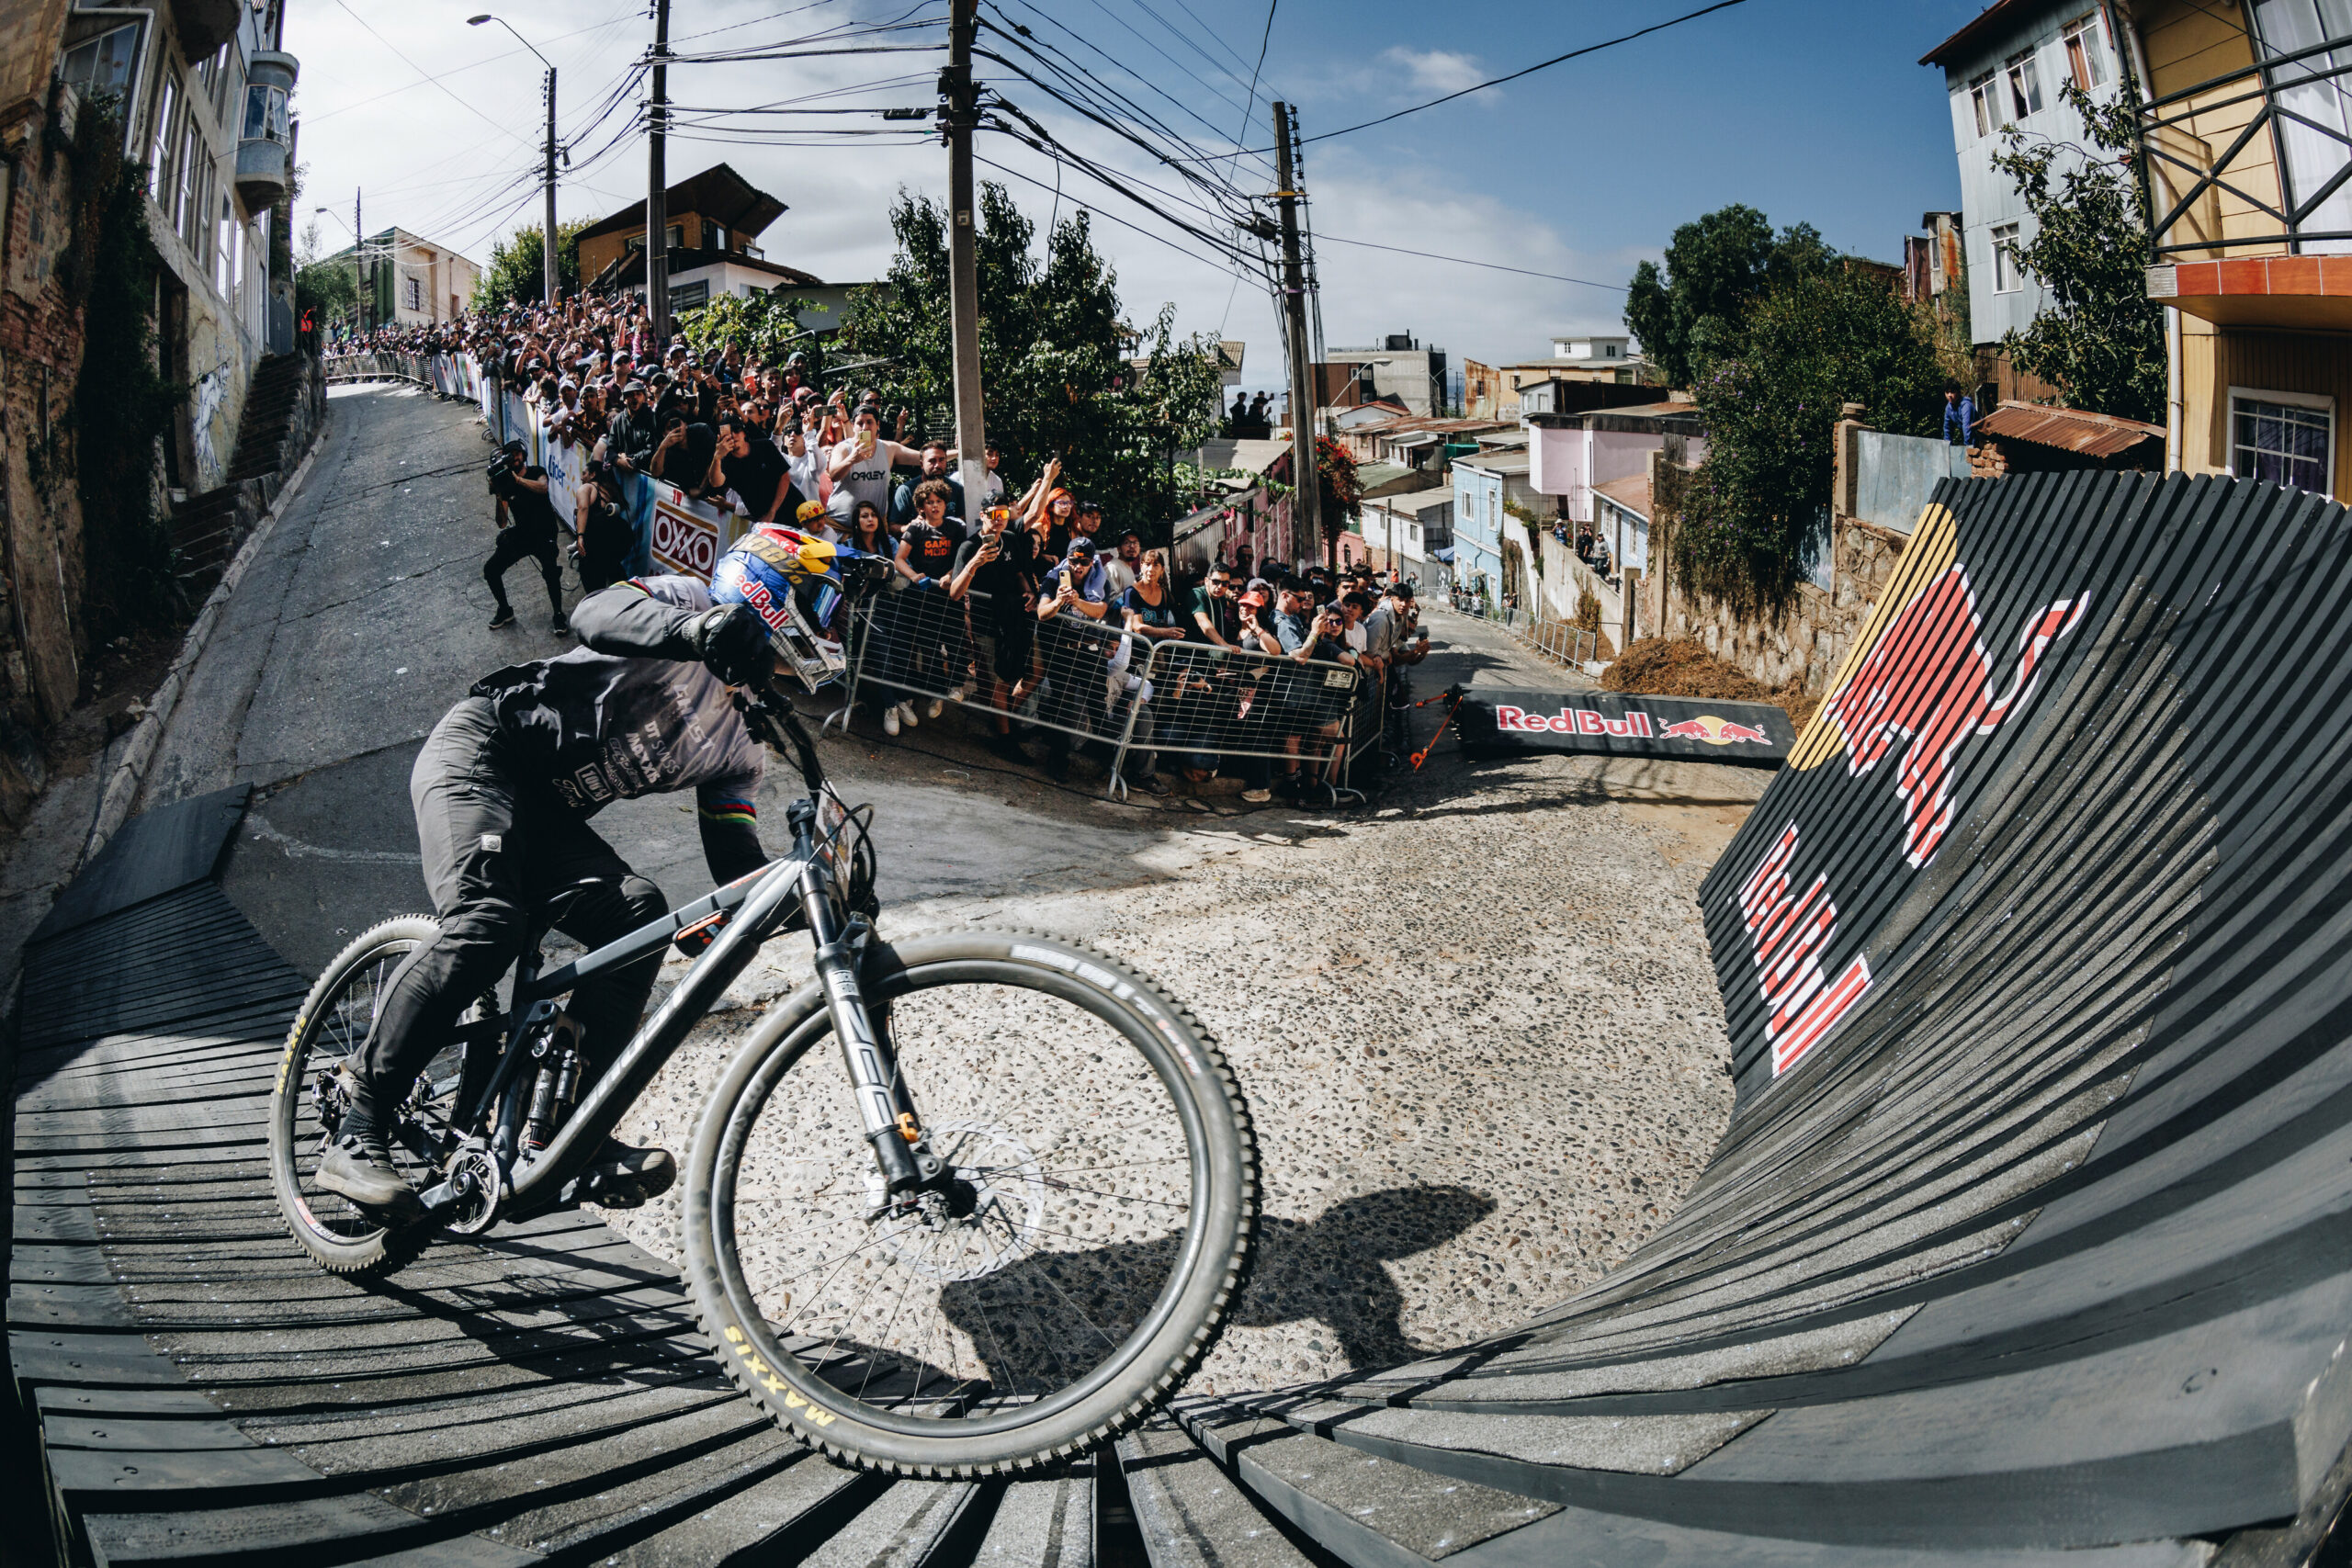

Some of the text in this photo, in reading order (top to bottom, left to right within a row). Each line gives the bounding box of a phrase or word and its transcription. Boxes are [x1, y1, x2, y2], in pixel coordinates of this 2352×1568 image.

[851, 470, 886, 480] OAKLEY
[655, 514, 714, 570] OXXO
[924, 548, 951, 557] MOD
[644, 720, 662, 739] DT
[276, 1016, 307, 1094] MAXXIS
[722, 1324, 836, 1428] MAXXIS
